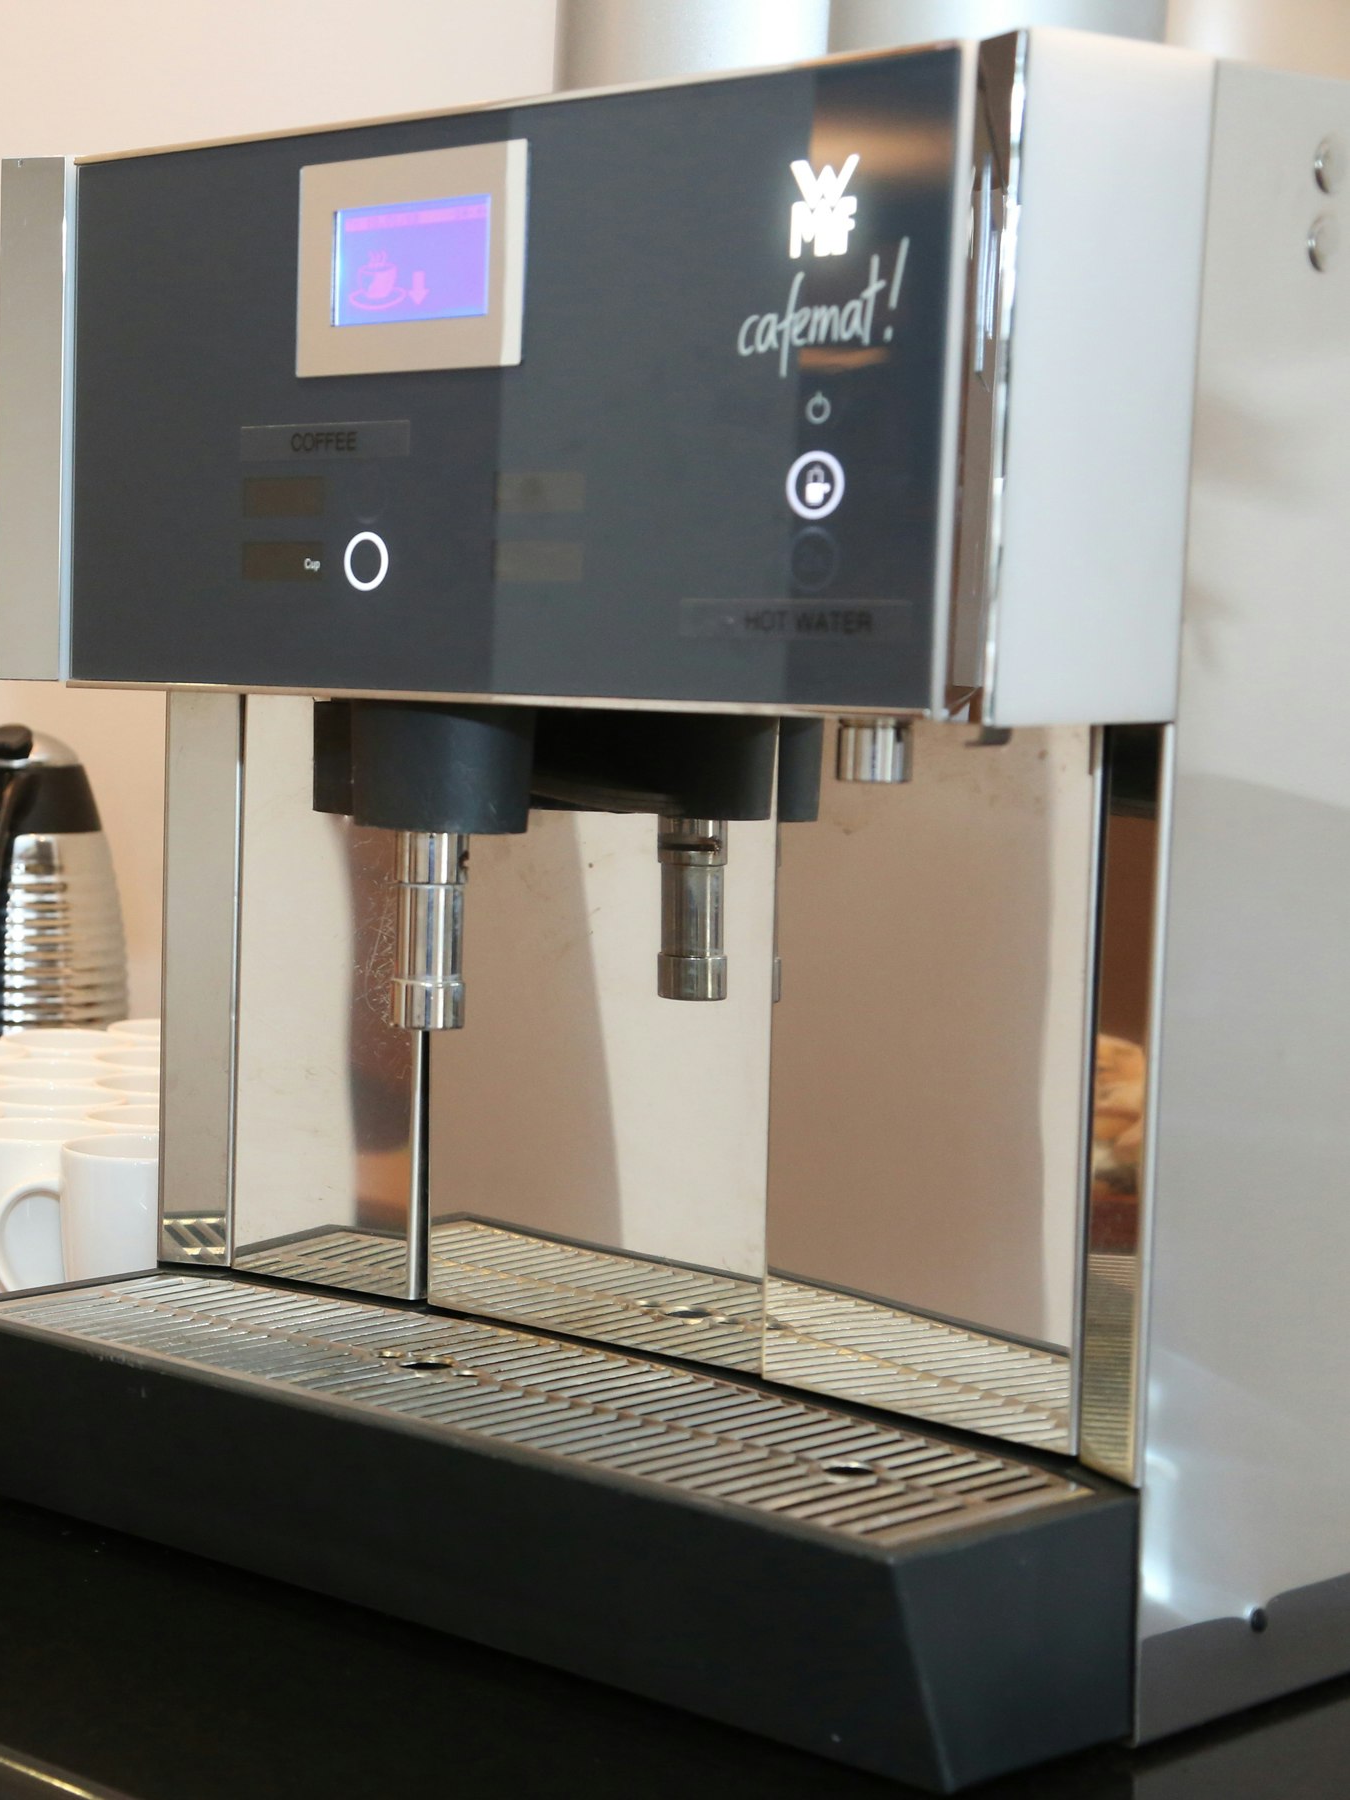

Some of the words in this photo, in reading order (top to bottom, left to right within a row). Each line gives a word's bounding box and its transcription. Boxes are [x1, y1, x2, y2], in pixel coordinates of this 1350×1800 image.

[789, 153, 860, 259] WMF
[736, 235, 910, 379] cafemat!
[290, 431, 358, 452] COFFEE
[303, 556, 321, 572] Cup
[745, 610, 788, 632] HOT
[795, 609, 873, 634] WATER
